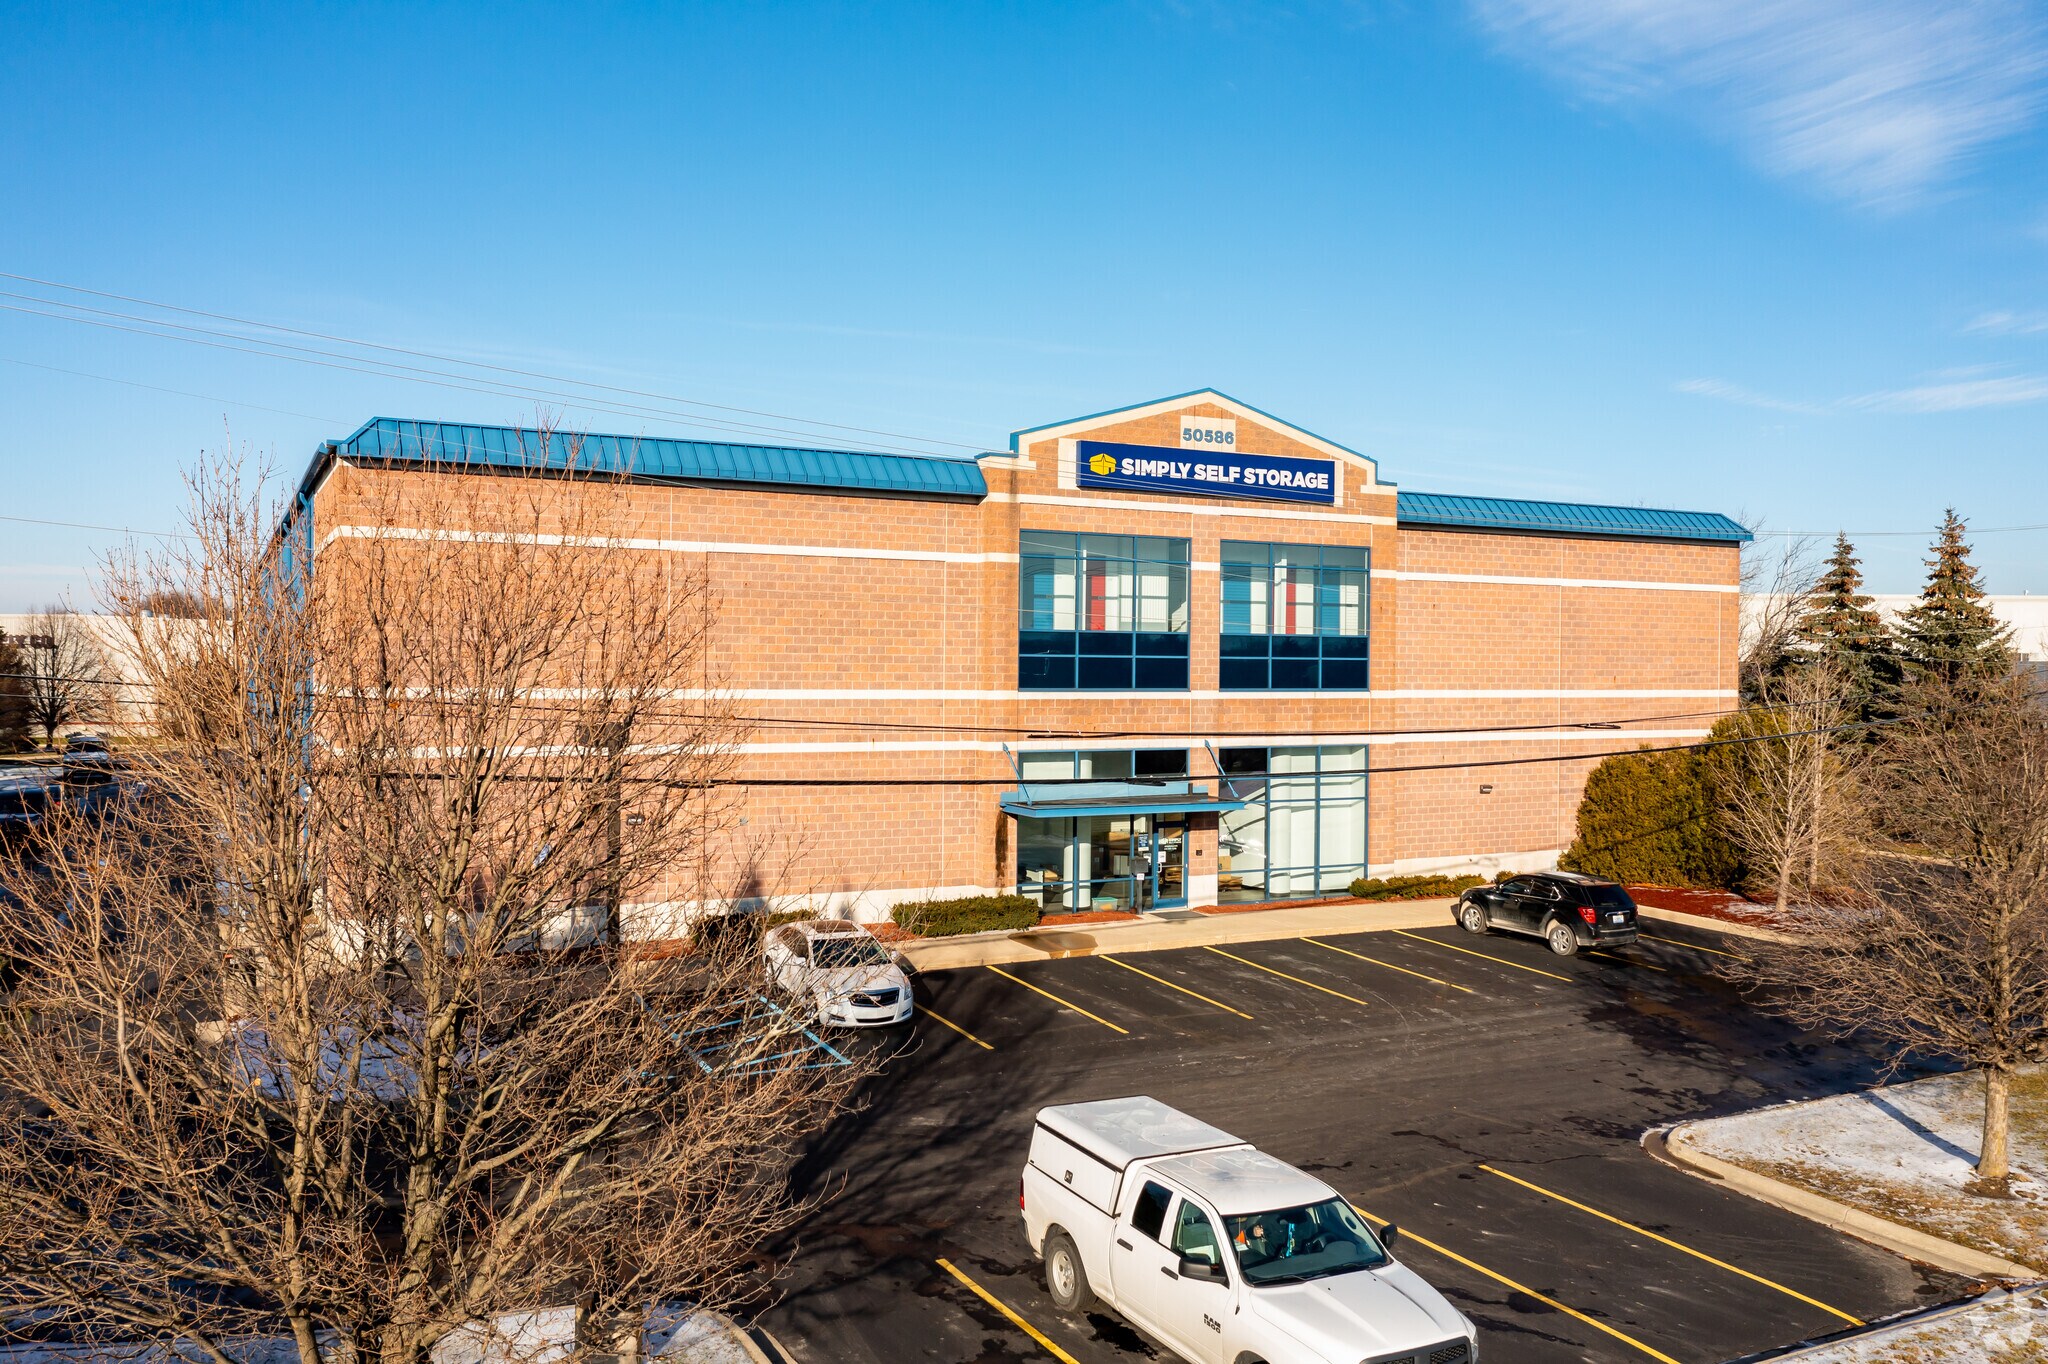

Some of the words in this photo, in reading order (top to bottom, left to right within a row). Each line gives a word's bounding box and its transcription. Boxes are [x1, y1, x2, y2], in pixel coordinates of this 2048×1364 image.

[1182, 427, 1234, 444] 50586
[1121, 458, 1192, 479] SIMPLY
[1193, 463, 1240, 482] SELF
[1243, 467, 1329, 489] STORAGE
[1204, 1313, 1221, 1329] RAM
